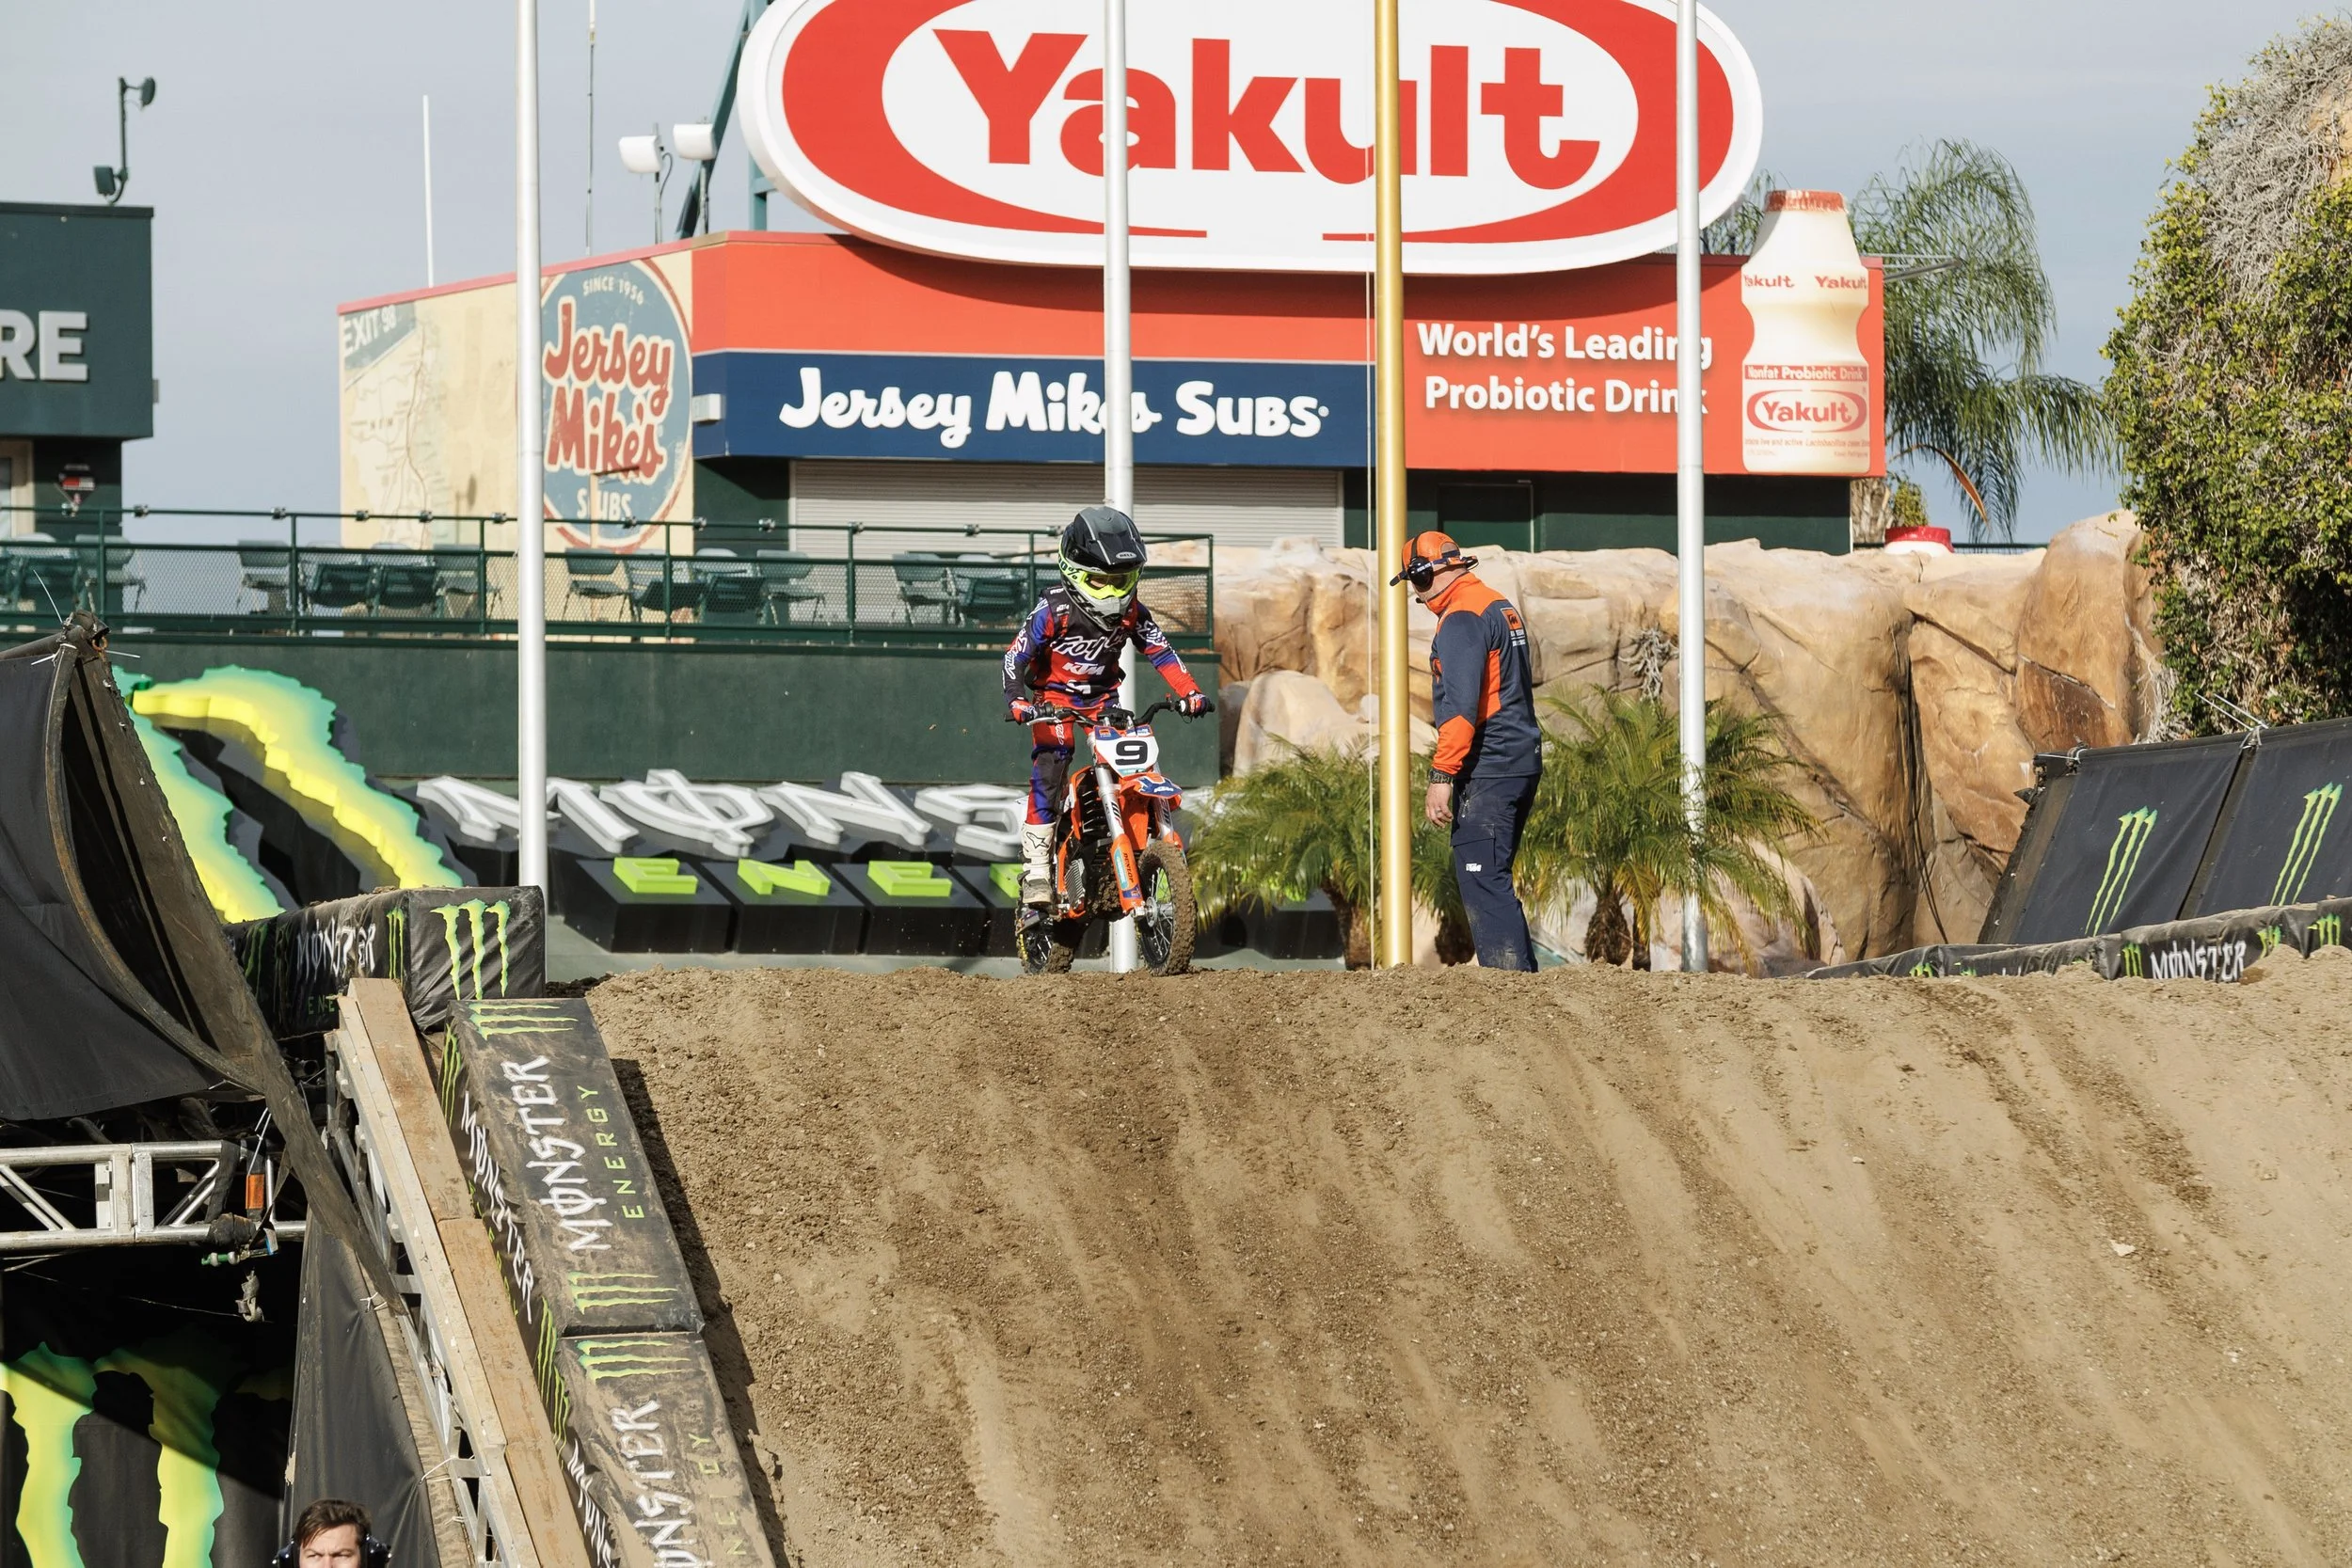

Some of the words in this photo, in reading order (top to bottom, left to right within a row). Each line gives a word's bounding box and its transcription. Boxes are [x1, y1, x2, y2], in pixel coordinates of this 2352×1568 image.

[932, 29, 1599, 190] Yakult
[582, 276, 614, 296] SINCE
[619, 278, 644, 306] 1956
[0, 309, 87, 381] RE
[343, 309, 379, 356] EXIT
[1417, 323, 1555, 358] World's
[545, 301, 671, 418] Jersey
[1781, 365, 1836, 380] Probiotic
[1839, 367, 1863, 380] Drink
[779, 367, 972, 449] Jersey
[985, 372, 1162, 435] Miks
[1426, 375, 1595, 412] Probiotic
[1762, 401, 1852, 422] Yakult
[548, 386, 662, 480] Mike's
[577, 487, 632, 522] SUBS
[1062, 661, 1105, 675] KTM
[1115, 740, 1148, 766] 9
[2150, 939, 2247, 981] MONSTER
[501, 1055, 612, 1252] MONSTER
[577, 1085, 645, 1219] ENERGY
